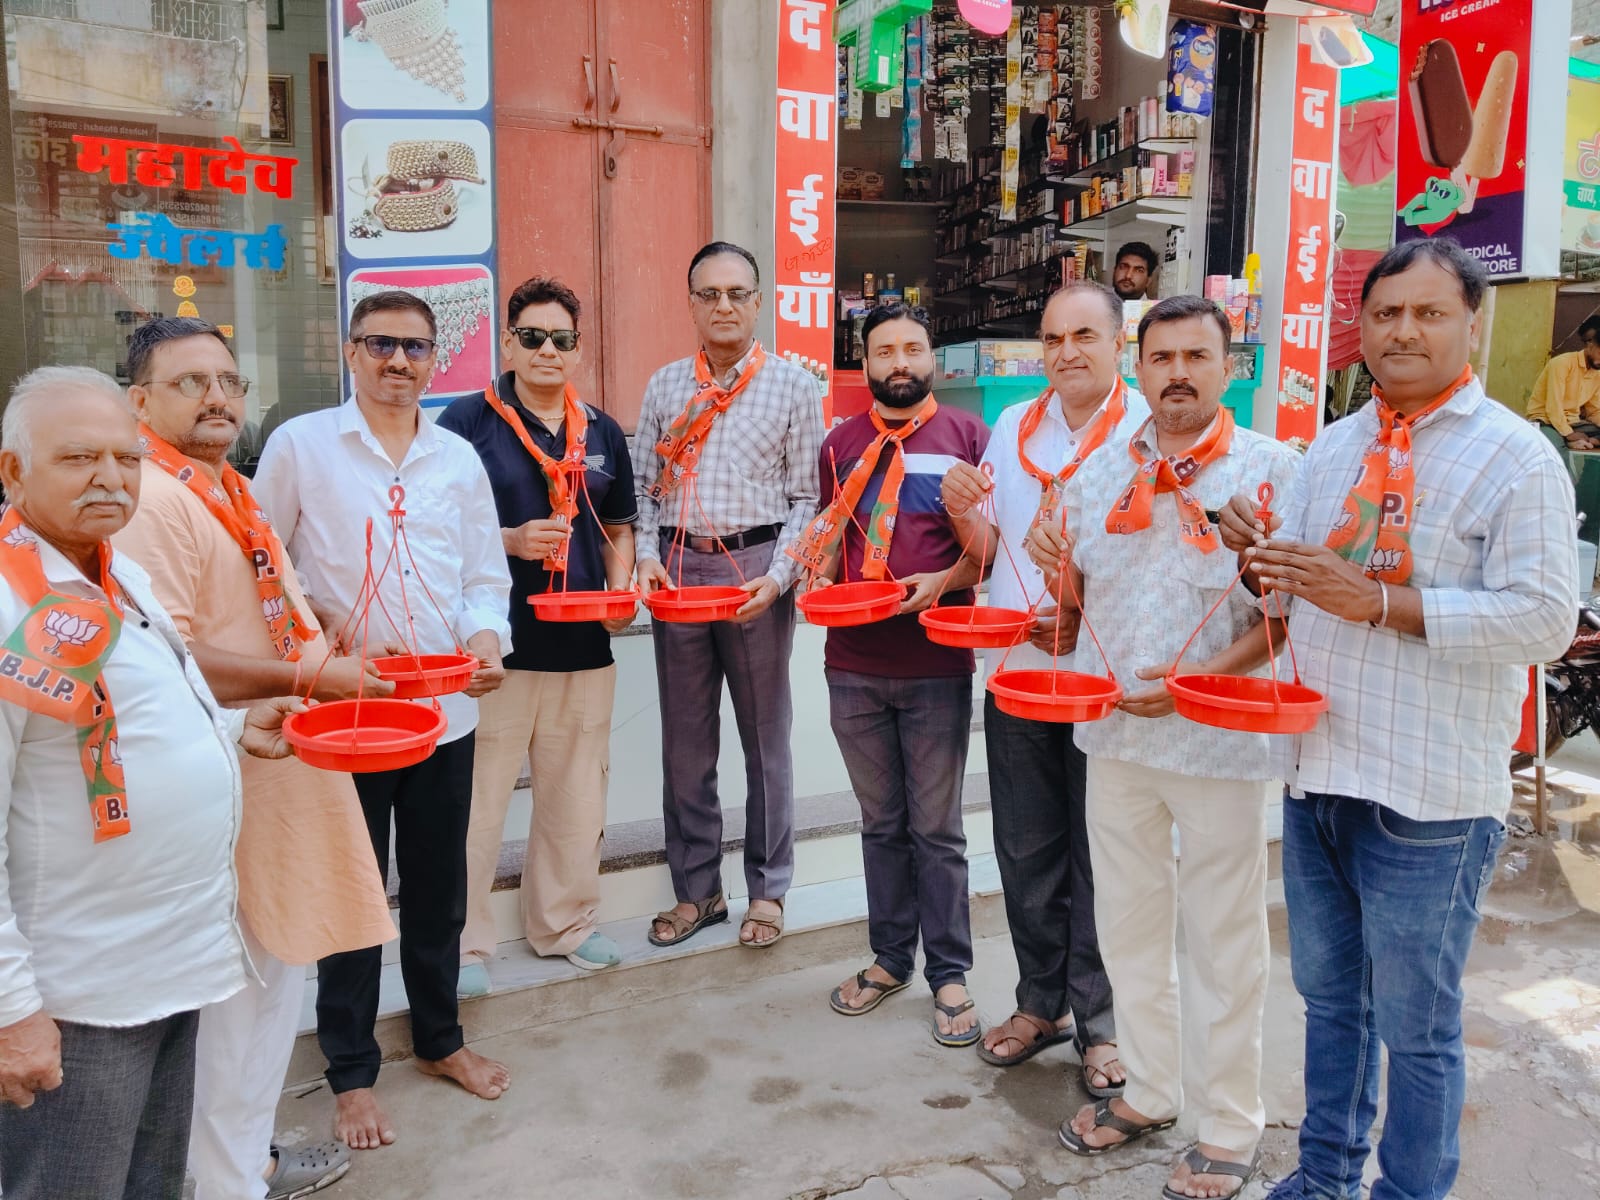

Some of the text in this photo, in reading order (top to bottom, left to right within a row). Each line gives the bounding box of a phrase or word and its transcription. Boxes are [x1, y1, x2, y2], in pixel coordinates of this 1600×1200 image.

[1440, 9, 1459, 22] ICE
[72, 134, 299, 200] महादेव
[1464, 243, 1512, 261] EDICAL
[1482, 257, 1518, 274] TORE
[0, 652, 76, 702] B.J.P.
